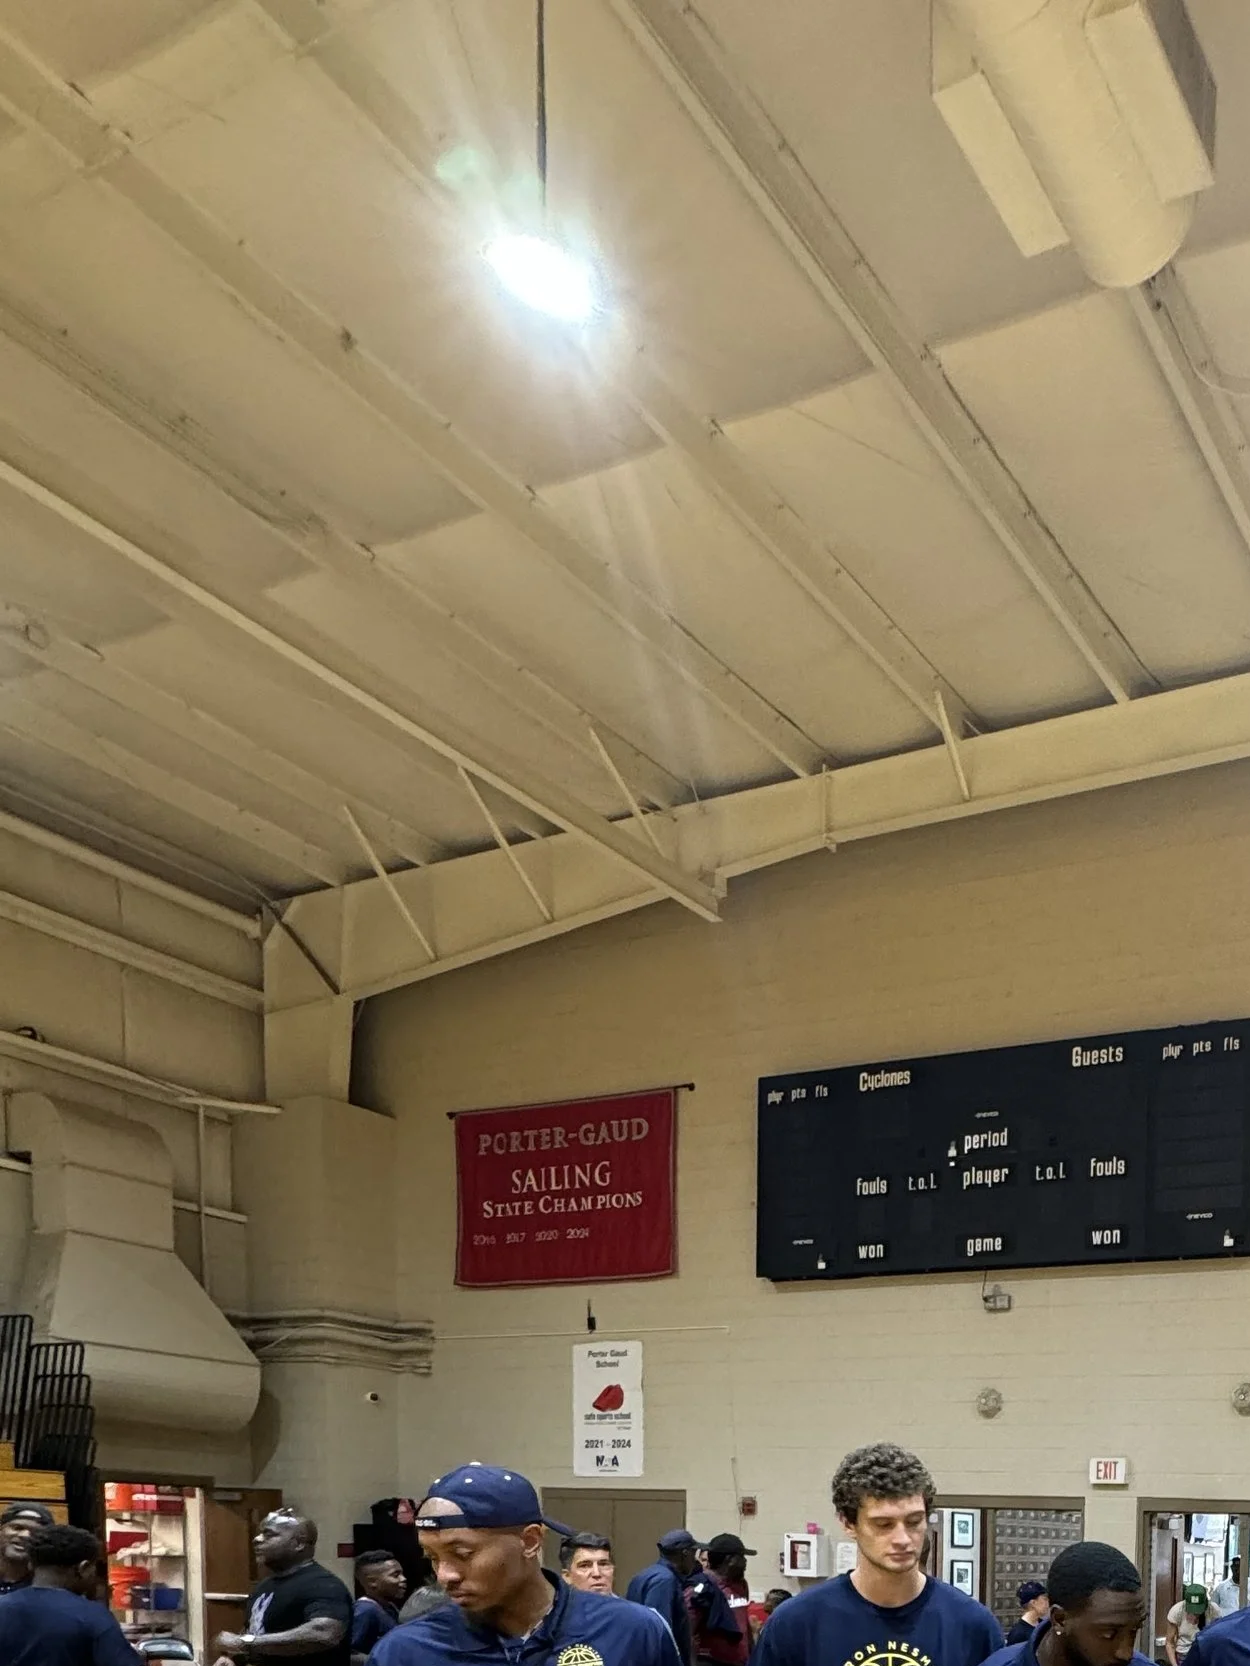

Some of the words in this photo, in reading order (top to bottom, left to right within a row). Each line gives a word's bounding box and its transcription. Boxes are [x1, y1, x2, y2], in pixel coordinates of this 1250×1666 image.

[1072, 1046, 1123, 1067] Guests
[1162, 1043, 1183, 1061] plyr
[1192, 1040, 1211, 1056] pts
[1223, 1036, 1240, 1051] fls
[791, 1088, 806, 1102] pts
[815, 1085, 828, 1098] fls
[860, 1070, 911, 1092] Cyclones
[478, 1117, 649, 1155] PORTER-GAUD
[964, 1128, 1008, 1154] period
[511, 1161, 611, 1194] SAILING
[857, 1177, 887, 1196] fouls
[963, 1167, 1009, 1190] player
[1090, 1156, 1125, 1177] fouls
[482, 1200, 534, 1219] STATE
[538, 1191, 643, 1215] CHAMPIONS
[858, 1243, 884, 1259] won
[966, 1237, 1002, 1257] game
[1092, 1229, 1121, 1245] won
[585, 1439, 604, 1449] 2021
[611, 1439, 632, 1449] 2024
[1096, 1460, 1119, 1480] EXIT
